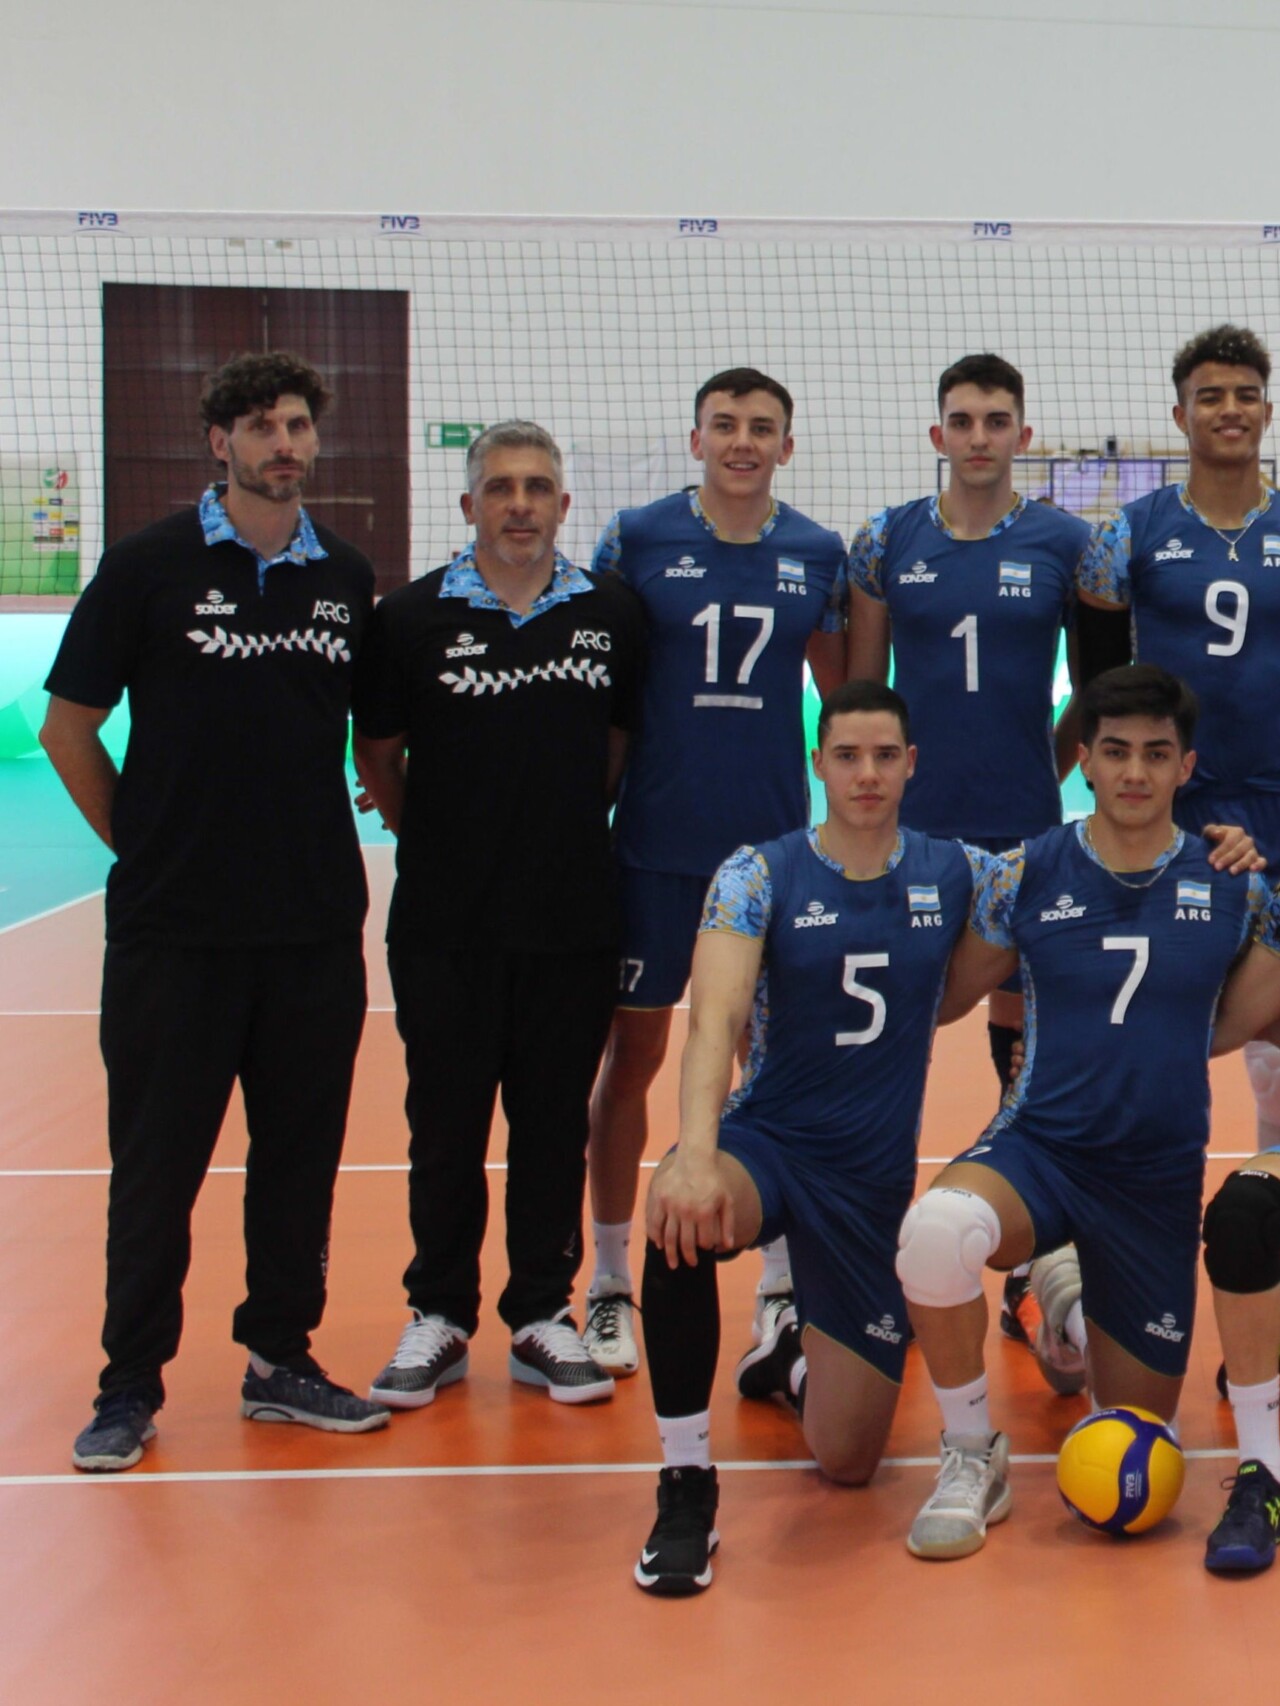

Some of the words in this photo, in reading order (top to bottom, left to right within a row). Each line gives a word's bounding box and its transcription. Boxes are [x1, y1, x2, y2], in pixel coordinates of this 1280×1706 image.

[78, 211, 119, 226] FIVB
[380, 216, 420, 230] FIVB
[679, 219, 718, 233] FIVB
[973, 222, 1012, 236] FIVB
[776, 580, 807, 595] ARG
[998, 584, 1032, 598] ARG
[312, 599, 351, 624] ARG
[1204, 579, 1250, 657] 9
[570, 629, 611, 652] ARG
[691, 602, 775, 685] 17
[950, 614, 979, 692] 1
[911, 914, 943, 928] ARG
[1174, 907, 1211, 921] ARG
[1102, 936, 1150, 1024] 7
[835, 952, 890, 1046] 5
[1125, 1473, 1135, 1499] FIVB
